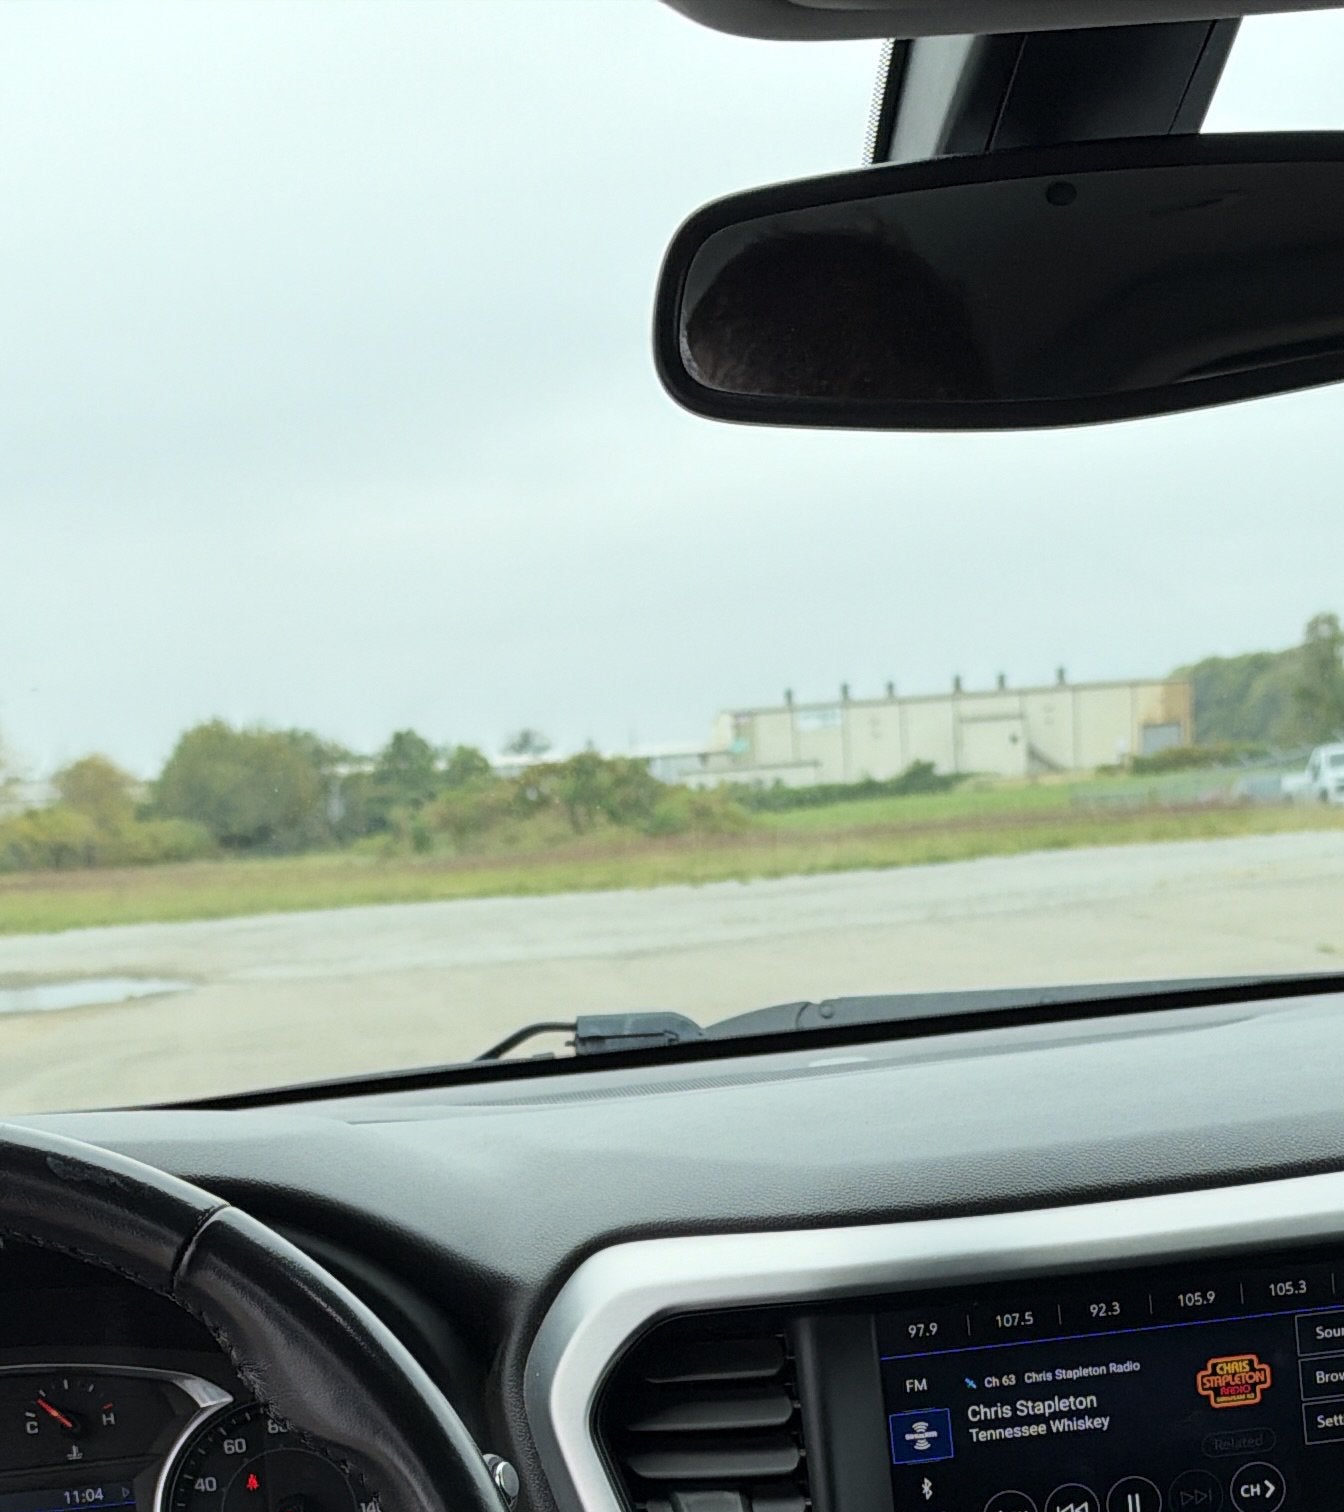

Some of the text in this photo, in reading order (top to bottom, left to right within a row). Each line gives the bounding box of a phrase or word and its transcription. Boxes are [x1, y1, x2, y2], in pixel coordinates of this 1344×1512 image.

[908, 1280, 1307, 1338] 97.9 107.5 92.3 105.9 105.3
[984, 1360, 1141, 1388] Ch 63 Chris Stapleton Radio
[1216, 1360, 1250, 1375] CHRIS
[906, 1378, 928, 1393] FM
[1202, 1370, 1265, 1389] STAPLETON
[967, 1395, 1098, 1422] Chris Stapleton
[102, 1411, 115, 1426] H
[26, 1421, 39, 1435] C
[969, 1415, 1110, 1443] Tennessee Whiskey
[223, 1438, 247, 1454] 60
[194, 1477, 217, 1492] 40
[1240, 1483, 1261, 1498] CH
[64, 1488, 104, 1505] 11:04
